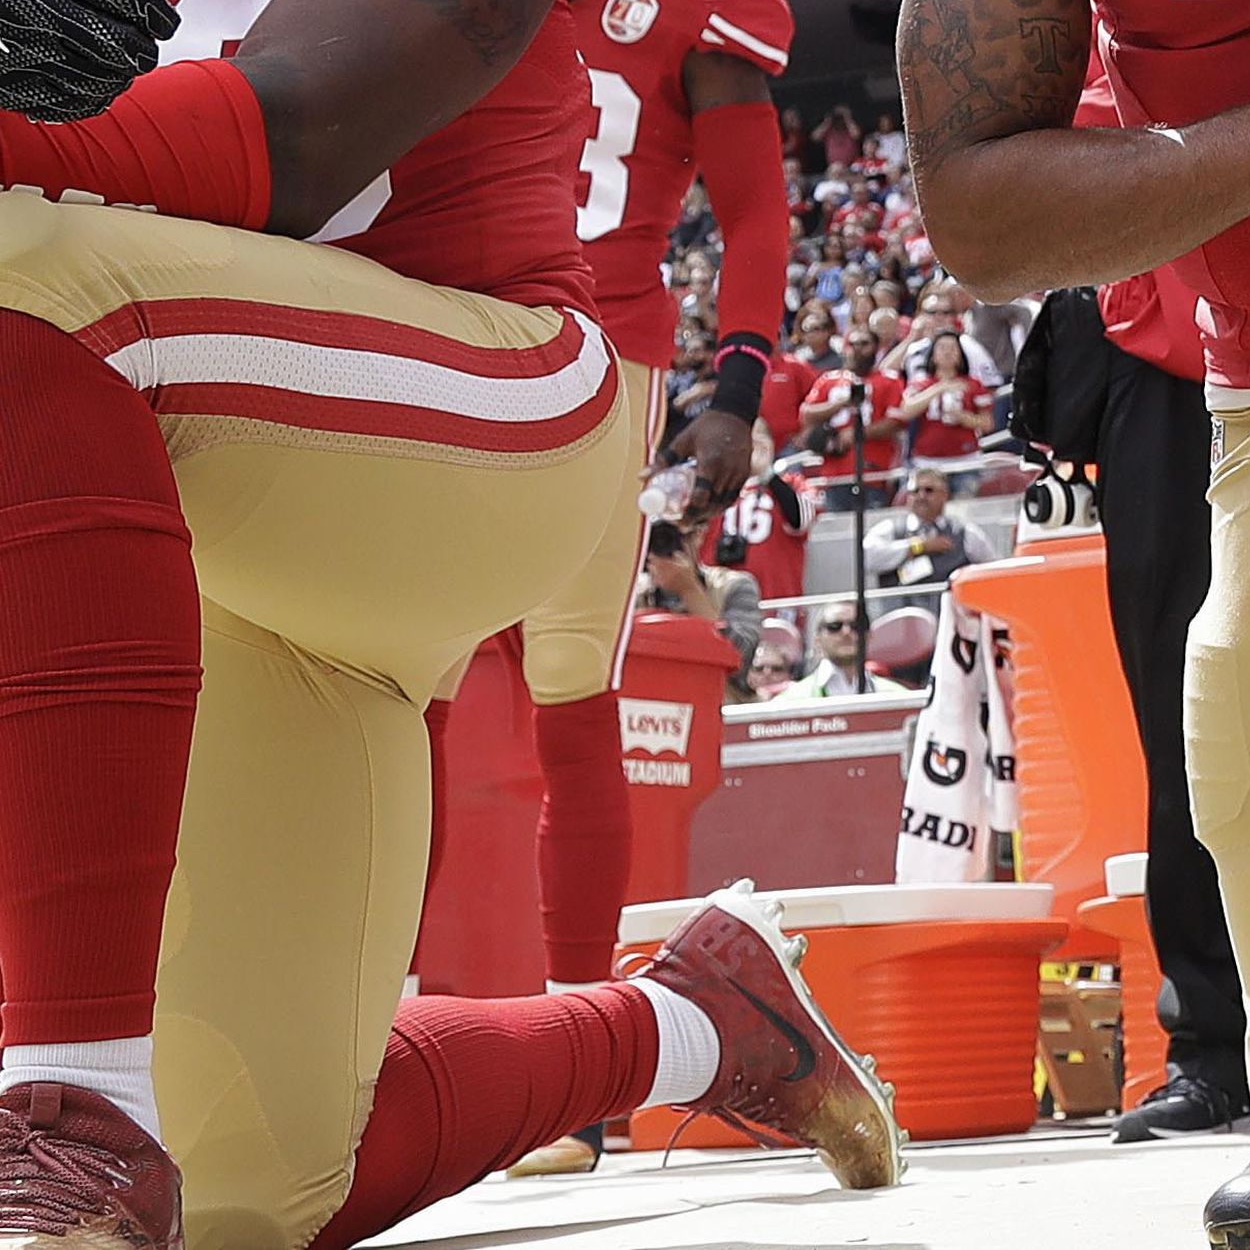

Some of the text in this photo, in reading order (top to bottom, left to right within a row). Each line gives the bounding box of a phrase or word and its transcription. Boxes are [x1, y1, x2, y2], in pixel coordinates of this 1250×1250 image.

[722, 491, 774, 544] 16
[749, 716, 849, 739] Shoulder Pads
